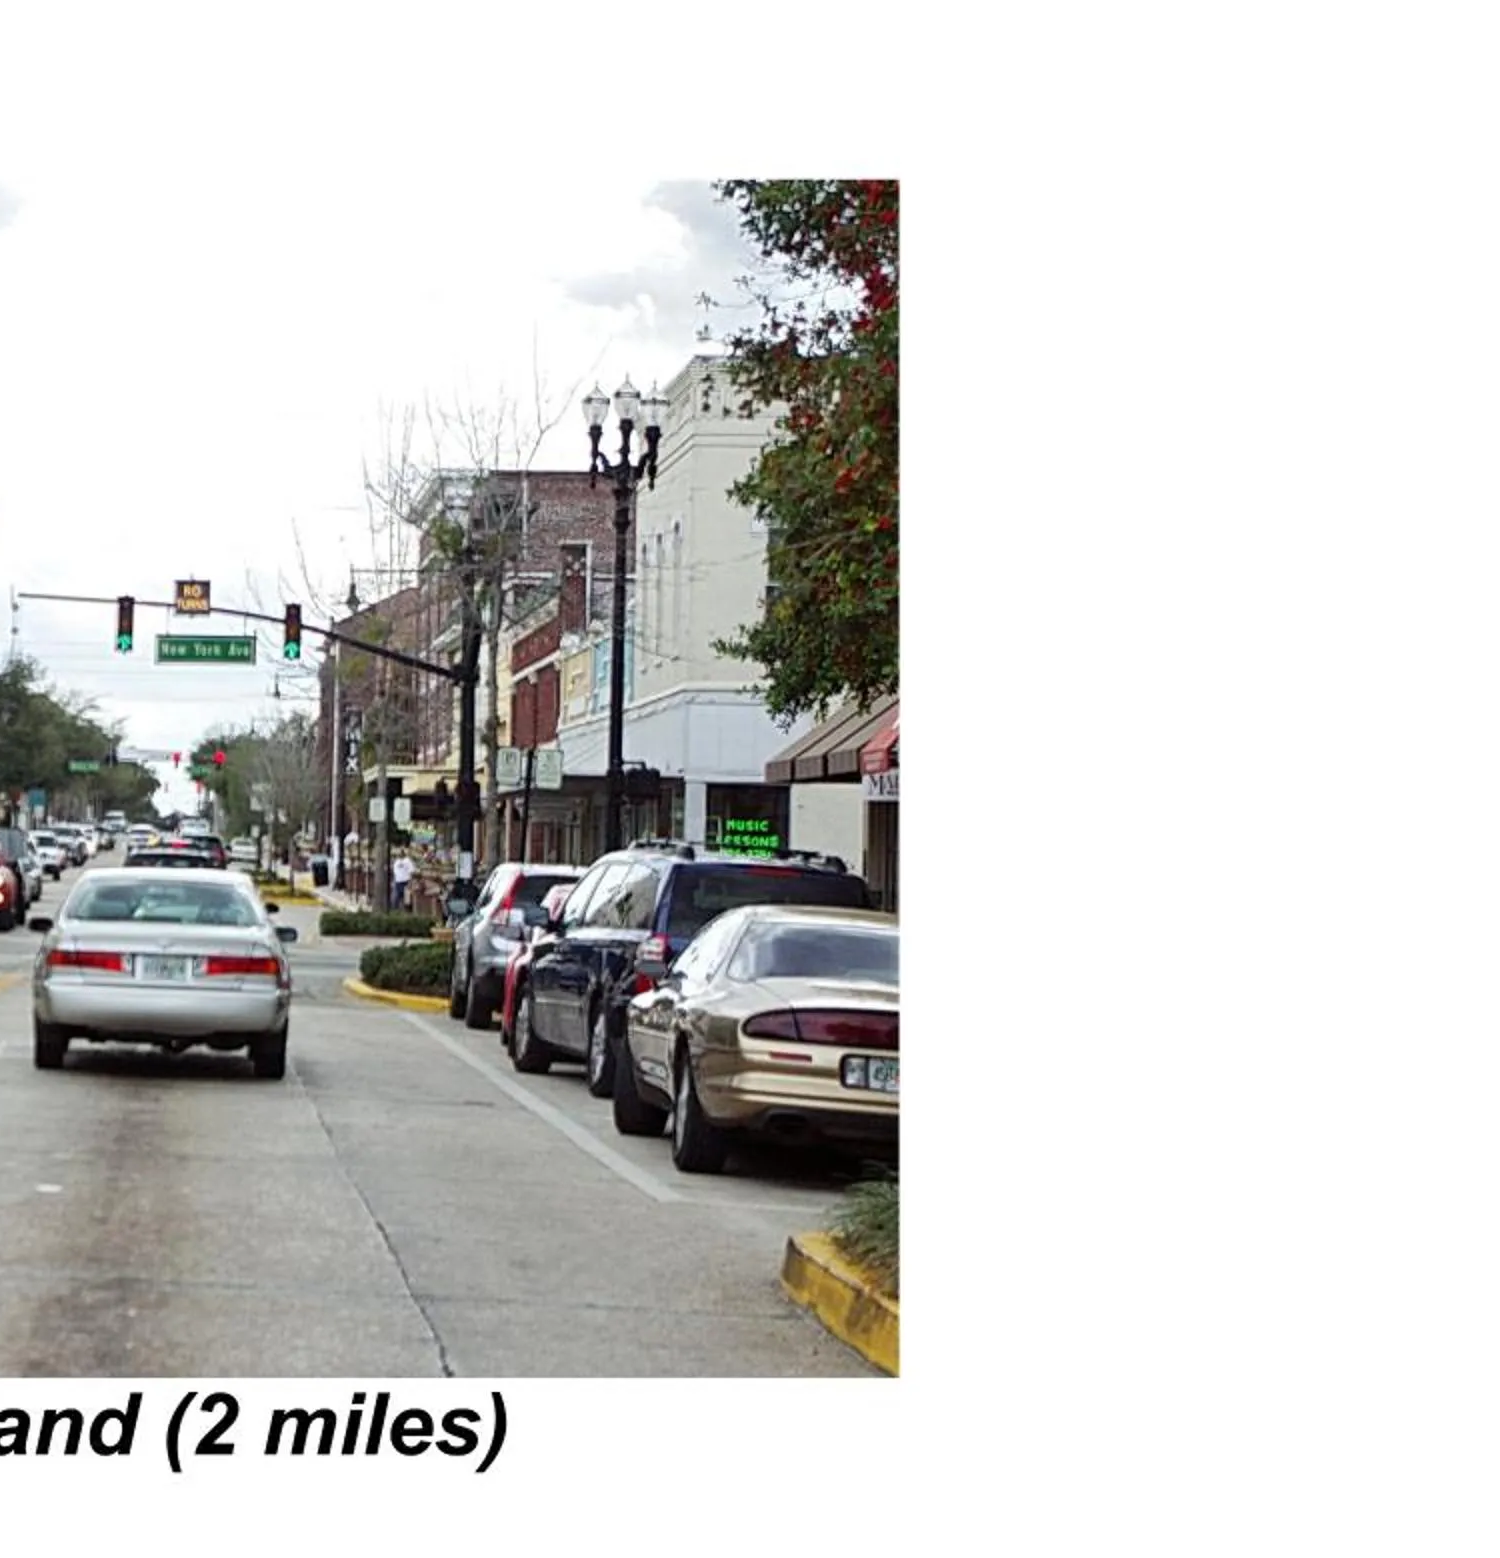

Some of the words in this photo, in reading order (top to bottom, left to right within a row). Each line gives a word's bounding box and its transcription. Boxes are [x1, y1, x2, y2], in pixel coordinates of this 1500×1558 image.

[183, 584, 202, 597] NO
[161, 643, 183, 655] New
[193, 643, 221, 655] York
[227, 643, 250, 656] Ave
[726, 819, 769, 832] MUSIC
